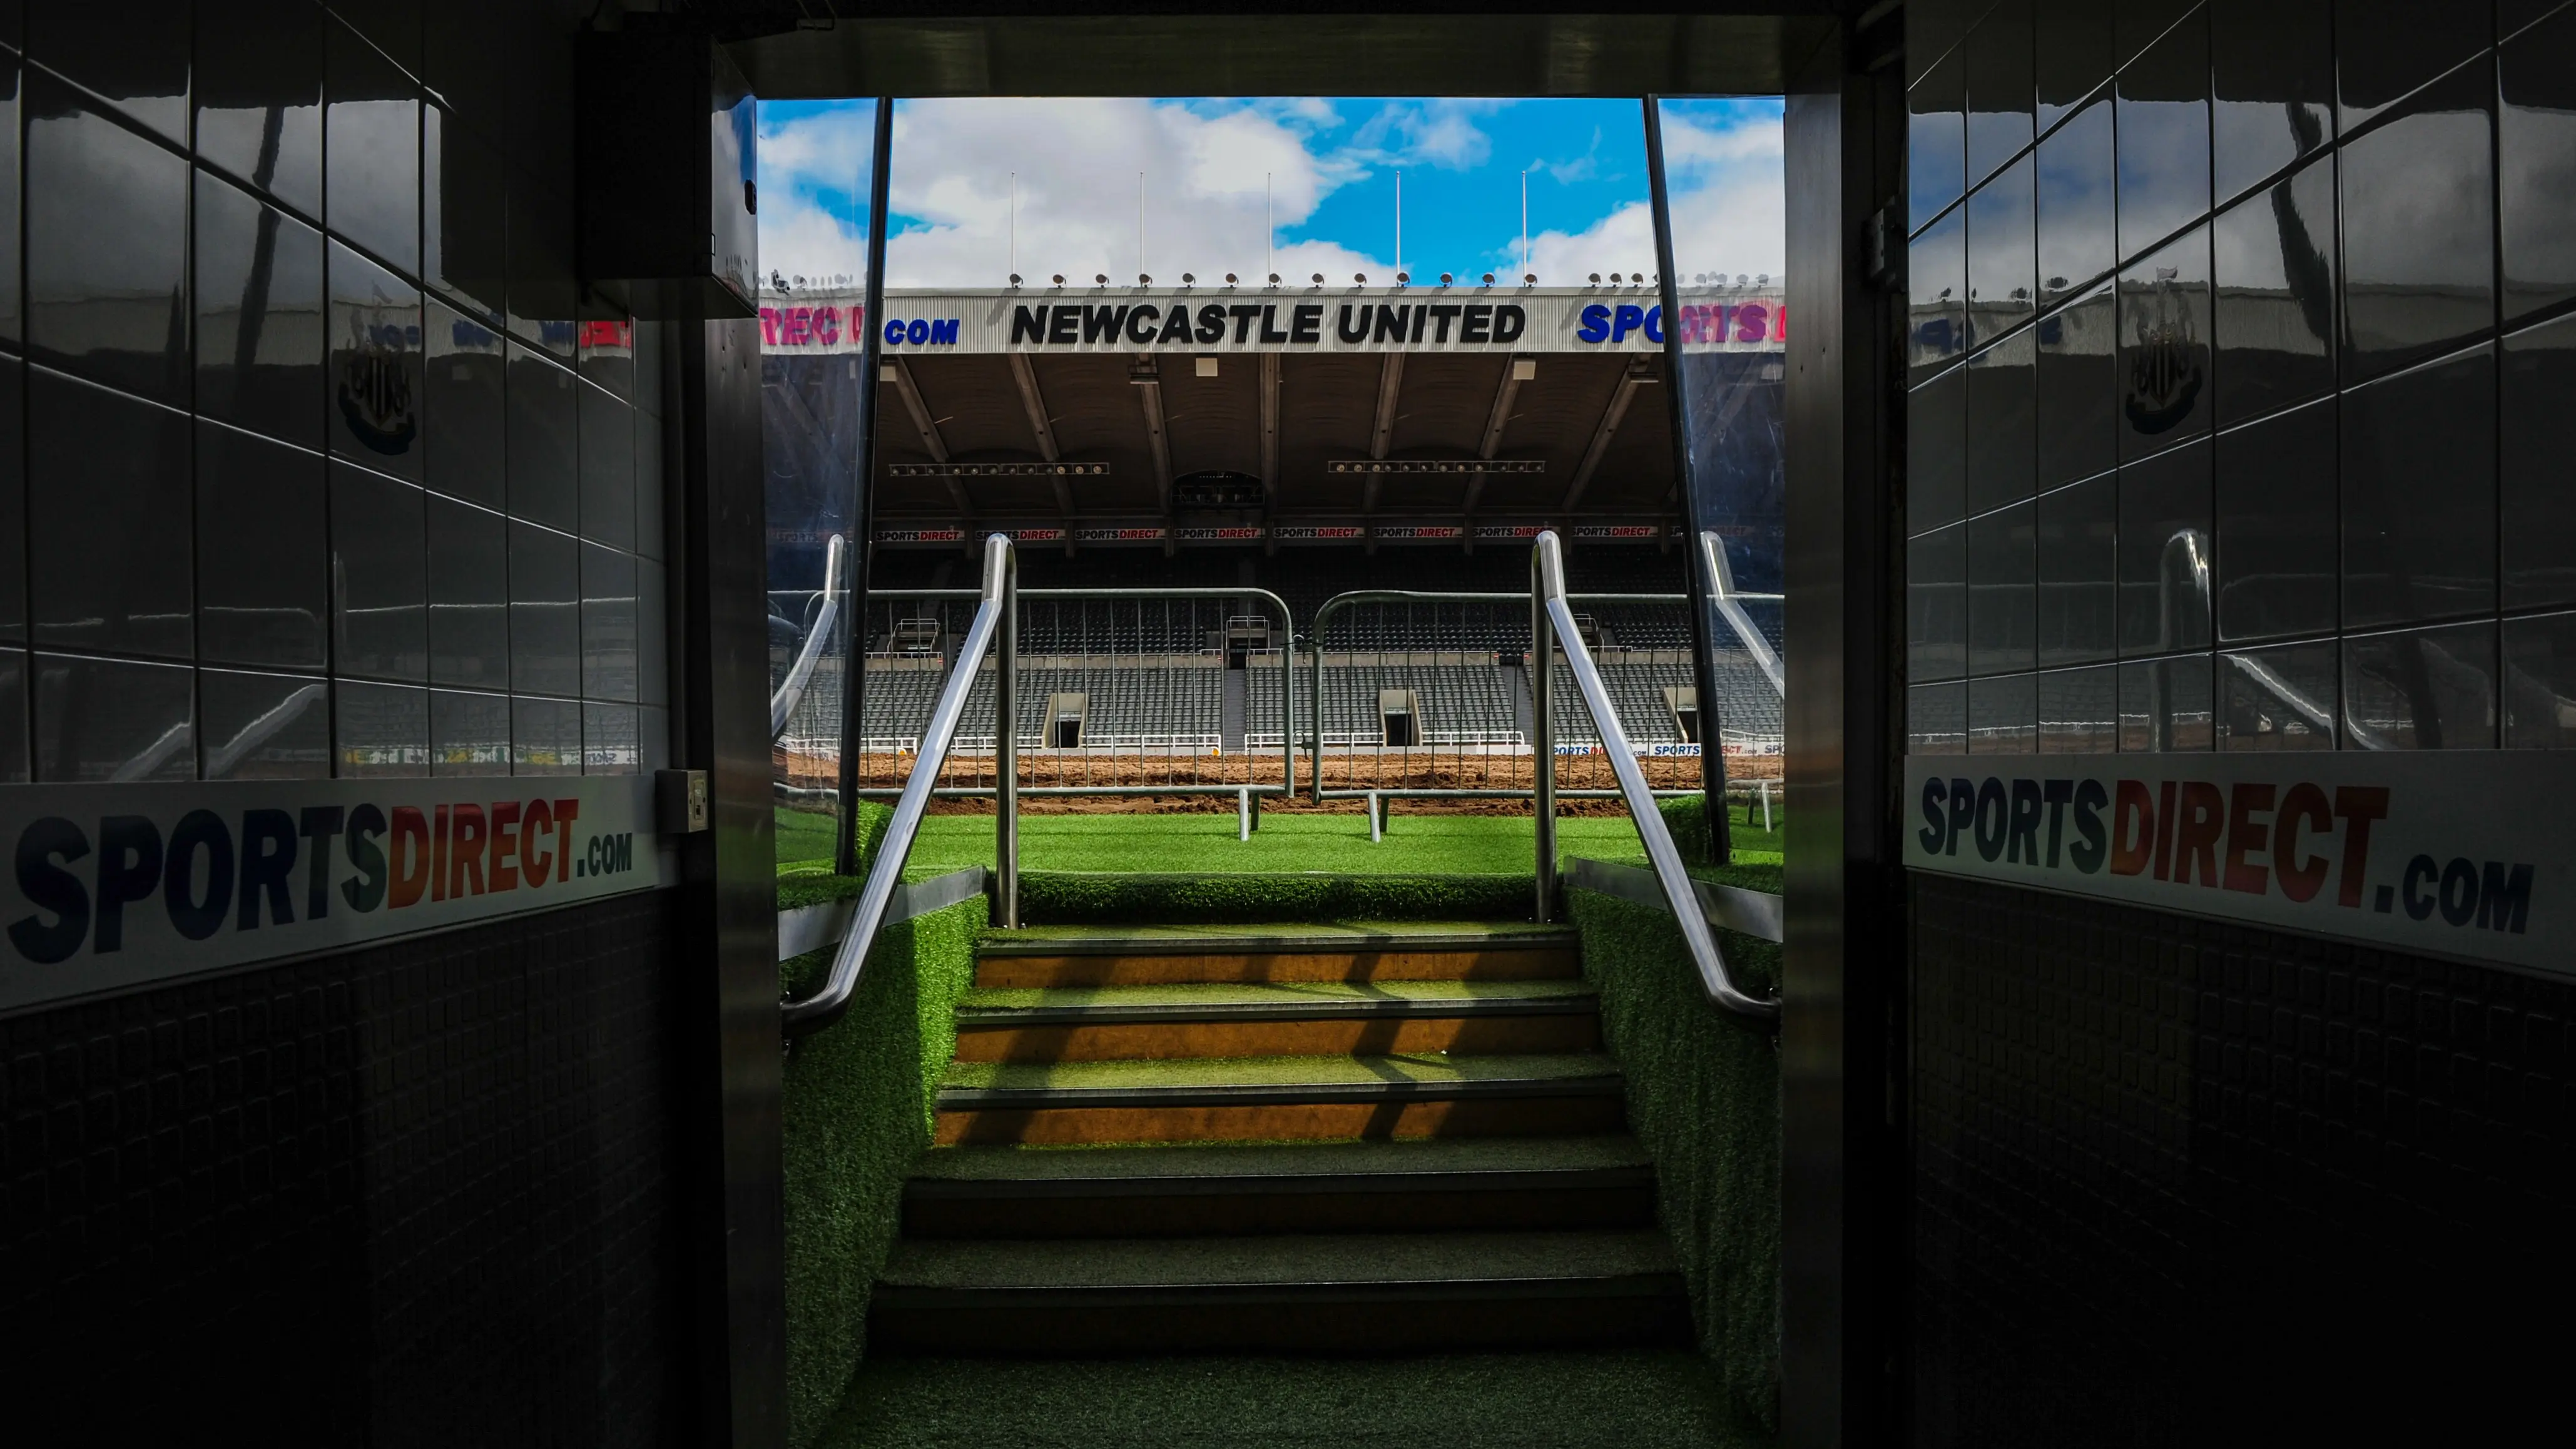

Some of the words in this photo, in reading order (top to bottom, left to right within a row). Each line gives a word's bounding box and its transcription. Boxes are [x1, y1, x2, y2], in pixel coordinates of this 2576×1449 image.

[1011, 304, 1323, 343] NEWCASTLE
[1338, 305, 1525, 343] UNITED
[8, 799, 633, 965] SPORTSDIRECT.COM
[1918, 776, 2533, 934] SPORTSDIRECT.COM
